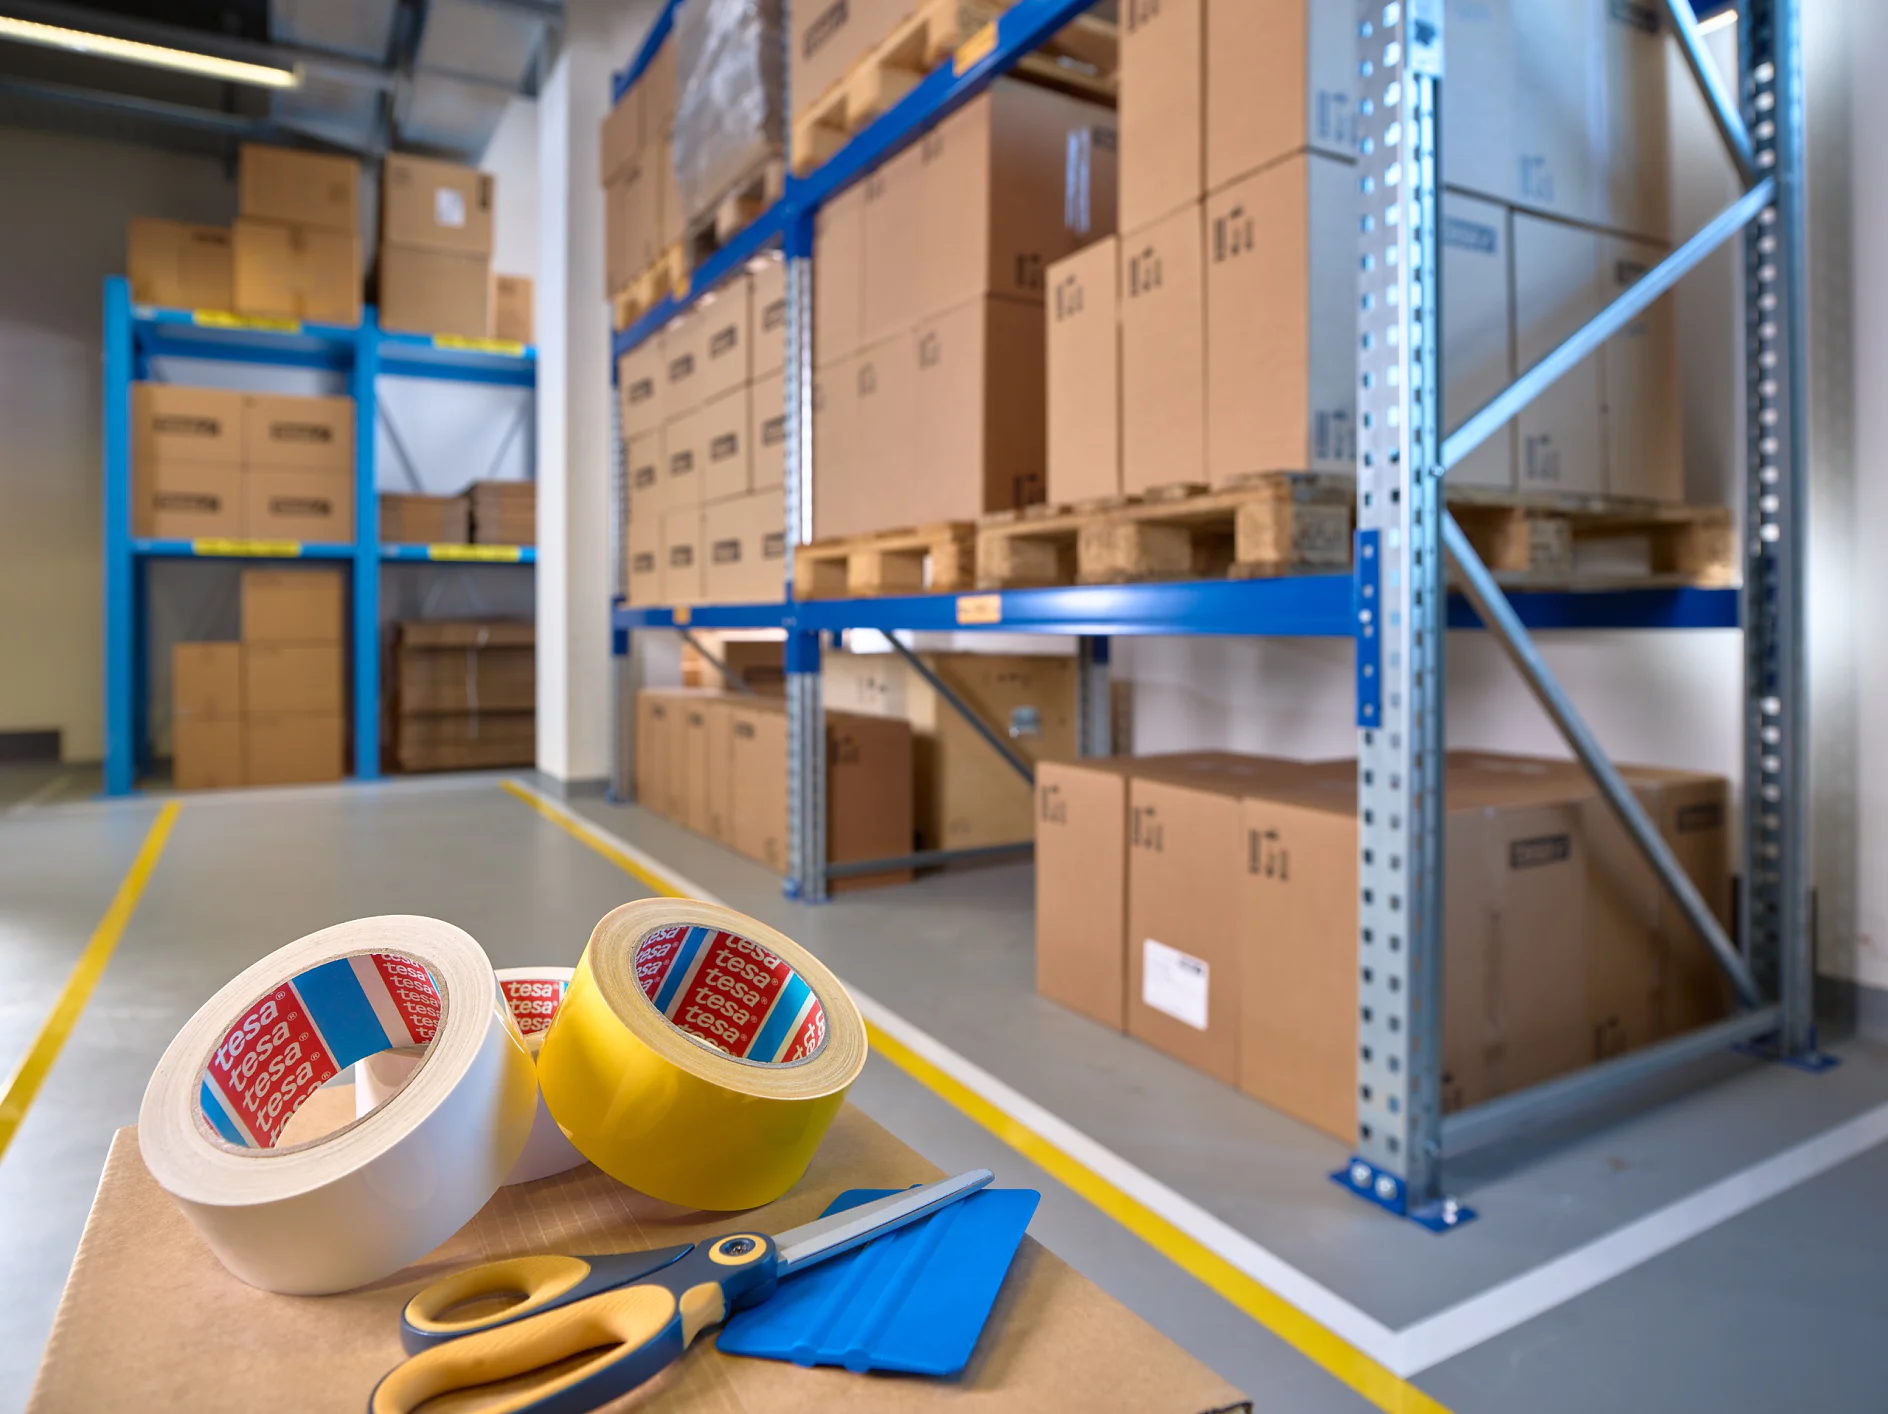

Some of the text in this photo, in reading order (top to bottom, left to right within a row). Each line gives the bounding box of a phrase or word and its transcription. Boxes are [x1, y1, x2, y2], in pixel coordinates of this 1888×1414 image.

[382, 962, 426, 982] tesa
[390, 975, 433, 996] tesa
[516, 1016, 553, 1031] esa
